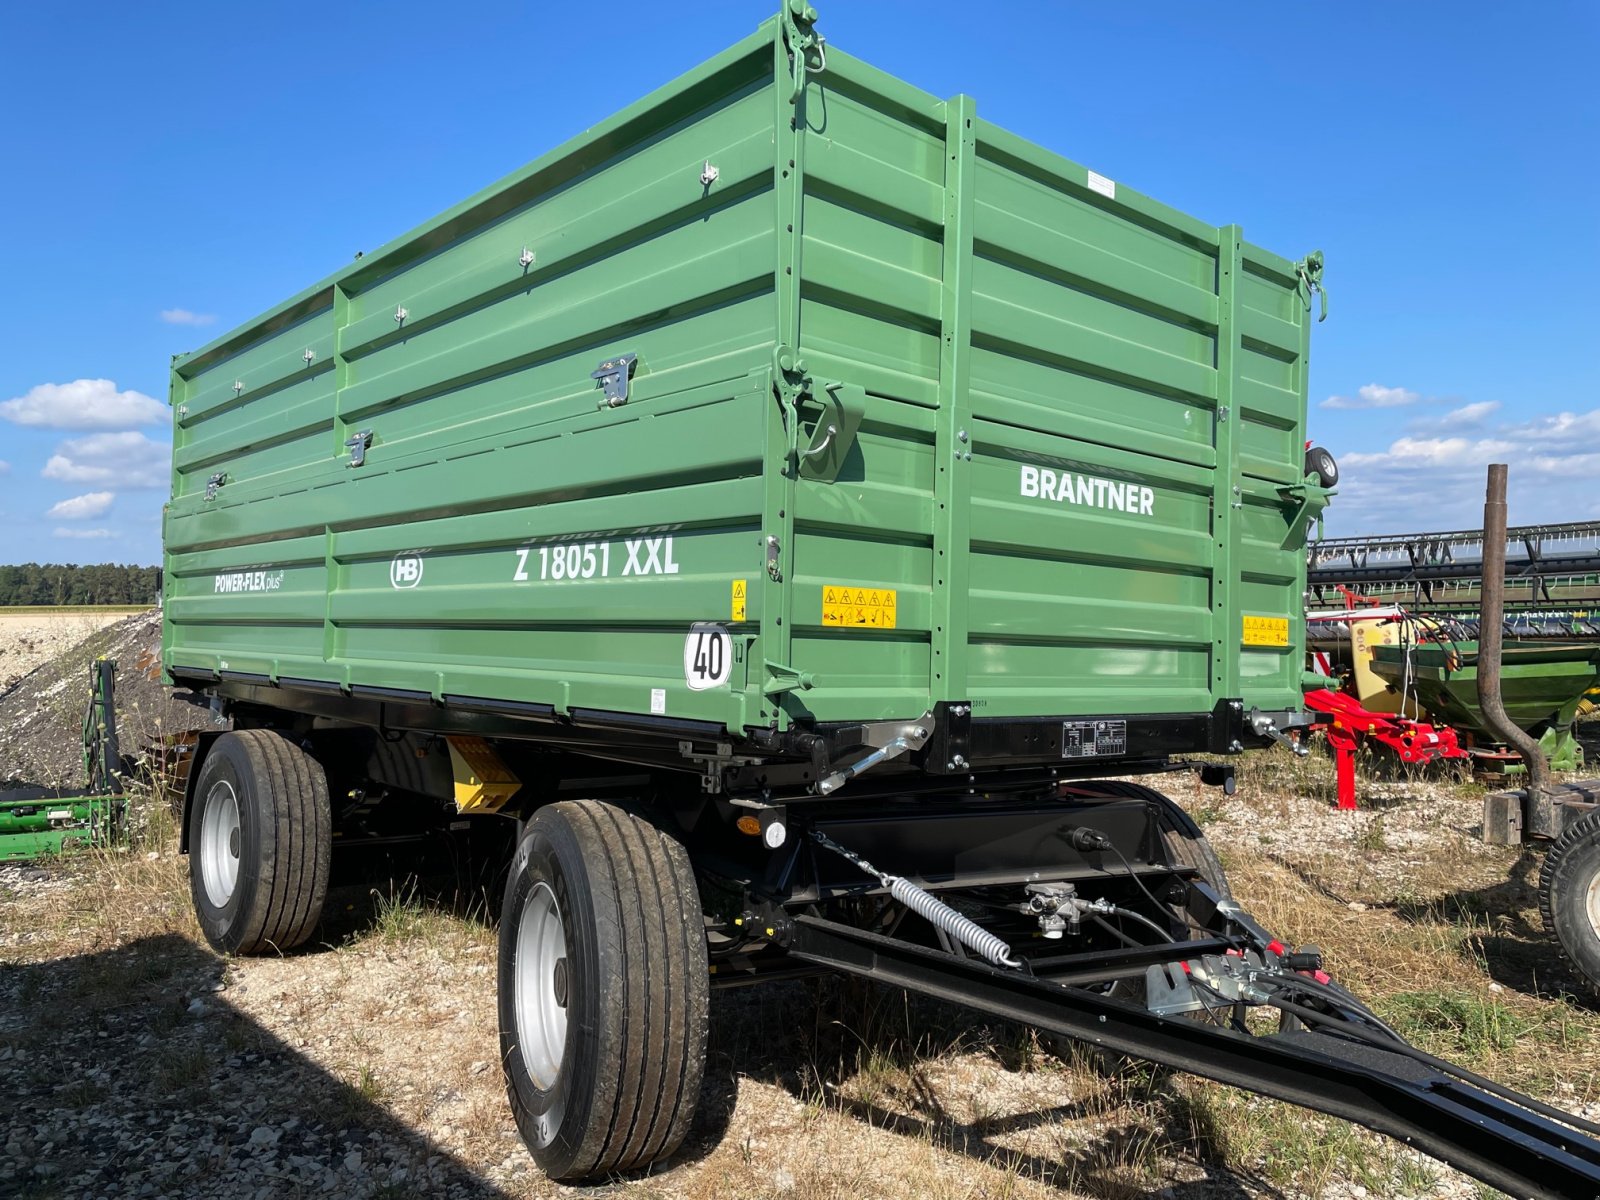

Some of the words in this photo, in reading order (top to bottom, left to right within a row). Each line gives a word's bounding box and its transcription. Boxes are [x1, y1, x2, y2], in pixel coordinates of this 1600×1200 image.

[1020, 465, 1154, 516] BRANTNER
[513, 546, 529, 581] Z
[539, 539, 610, 580] 18051
[621, 534, 679, 576] XXL
[214, 571, 266, 593] POWER-FLEX
[693, 631, 723, 680] 40
